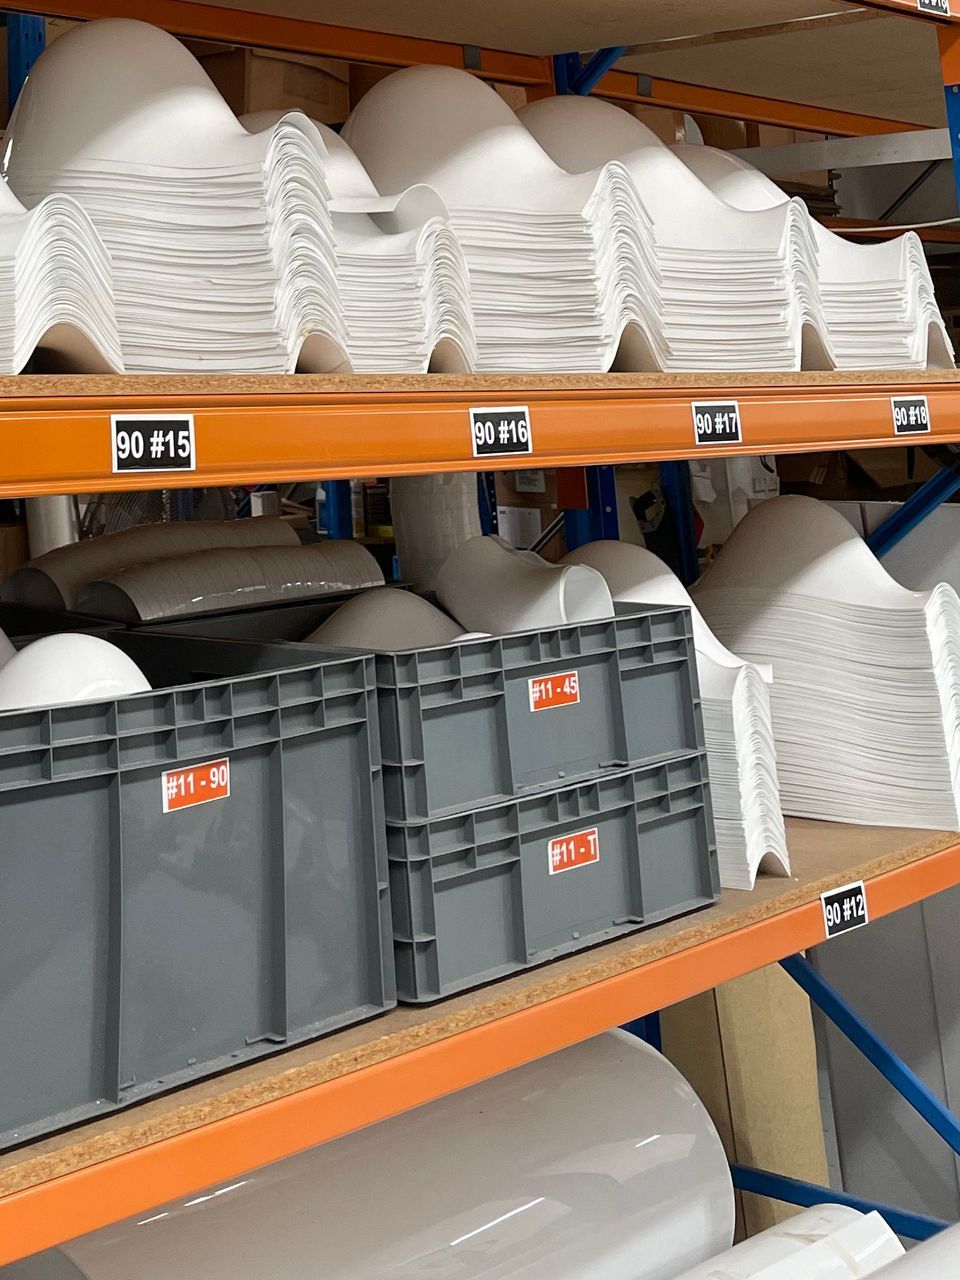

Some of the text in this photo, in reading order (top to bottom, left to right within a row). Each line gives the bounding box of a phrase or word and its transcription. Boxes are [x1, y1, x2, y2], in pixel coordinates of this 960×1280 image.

[696, 412, 737, 434] 90 #17
[895, 406, 927, 425] 90 #18
[117, 430, 191, 459] 90 #15
[474, 420, 528, 445] 90 #16
[531, 680, 553, 701] #11
[563, 676, 577, 696] 45
[166, 773, 195, 800] #11
[210, 765, 227, 789] 90
[552, 840, 575, 866] #11
[587, 834, 597, 855] T
[825, 894, 865, 926] 90 #12
